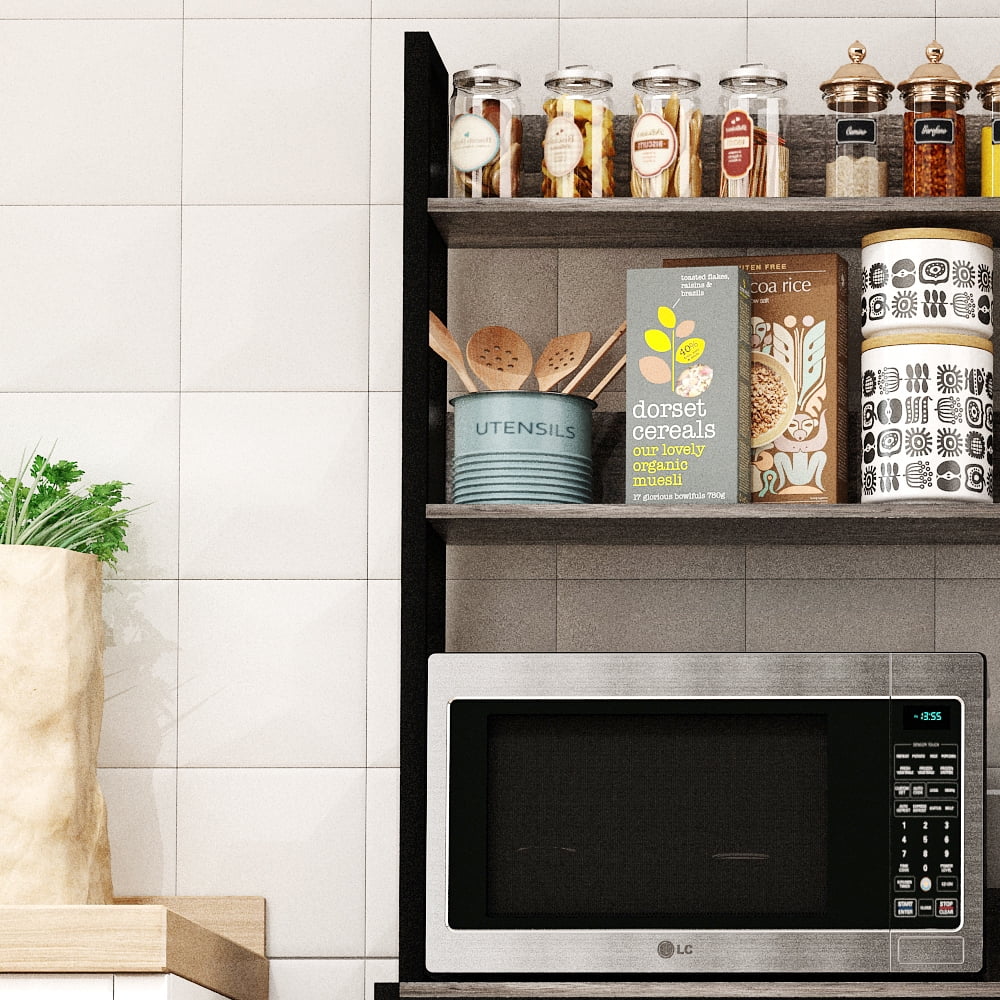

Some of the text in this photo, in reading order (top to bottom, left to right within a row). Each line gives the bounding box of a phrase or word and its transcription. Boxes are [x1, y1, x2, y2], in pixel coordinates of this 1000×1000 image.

[680, 273, 706, 281] toasted
[750, 280, 778, 294] coa
[782, 277, 812, 293] rice
[632, 398, 707, 419] dorset
[475, 421, 576, 440] UTENSILS
[632, 420, 716, 441] cereals
[632, 443, 706, 458] our lovely
[632, 458, 689, 474] organic
[632, 473, 683, 487] muesli
[643, 492, 673, 502] glorious
[674, 492, 706, 500] bowlfuls
[901, 821, 907, 830] 1
[922, 821, 928, 830] 2
[944, 821, 950, 830] 3
[901, 835, 907, 844] 4
[922, 835, 928, 844] 5
[944, 835, 950, 844] 6
[901, 849, 907, 858] 7
[922, 849, 928, 858] 8
[944, 849, 950, 858] 9
[922, 864, 928, 872] 0
